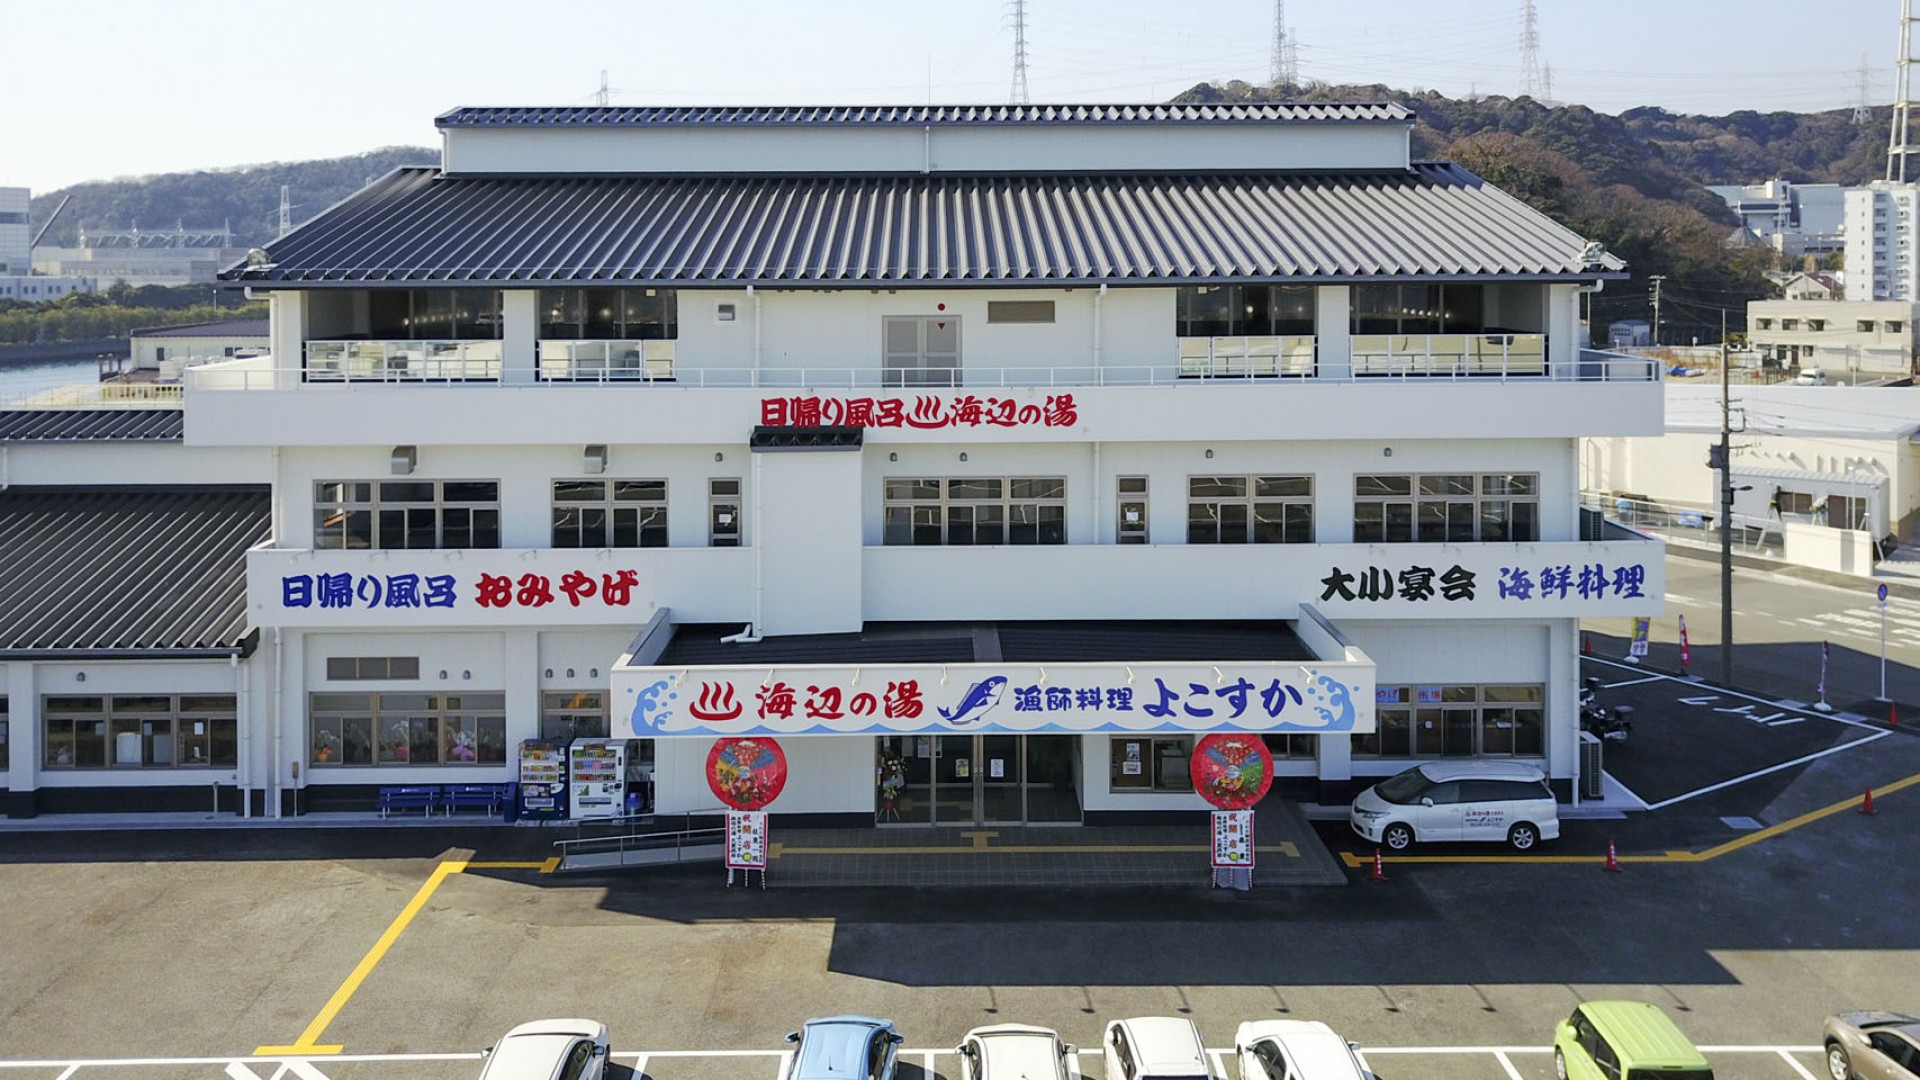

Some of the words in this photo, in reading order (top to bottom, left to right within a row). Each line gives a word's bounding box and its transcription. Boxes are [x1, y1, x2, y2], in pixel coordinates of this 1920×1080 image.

[761, 396, 905, 428] 日帰り風呂
[949, 393, 1078, 428] 海辺の湯
[281, 572, 457, 609] 日帰り風呂
[475, 569, 639, 608] おみやげ
[1320, 564, 1476, 602] 大小宴会
[1498, 563, 1645, 600] 海鮮料理
[755, 679, 924, 721] 海辺の湯
[1014, 685, 1134, 712] 漁師料理
[1143, 676, 1304, 719] よこすか
